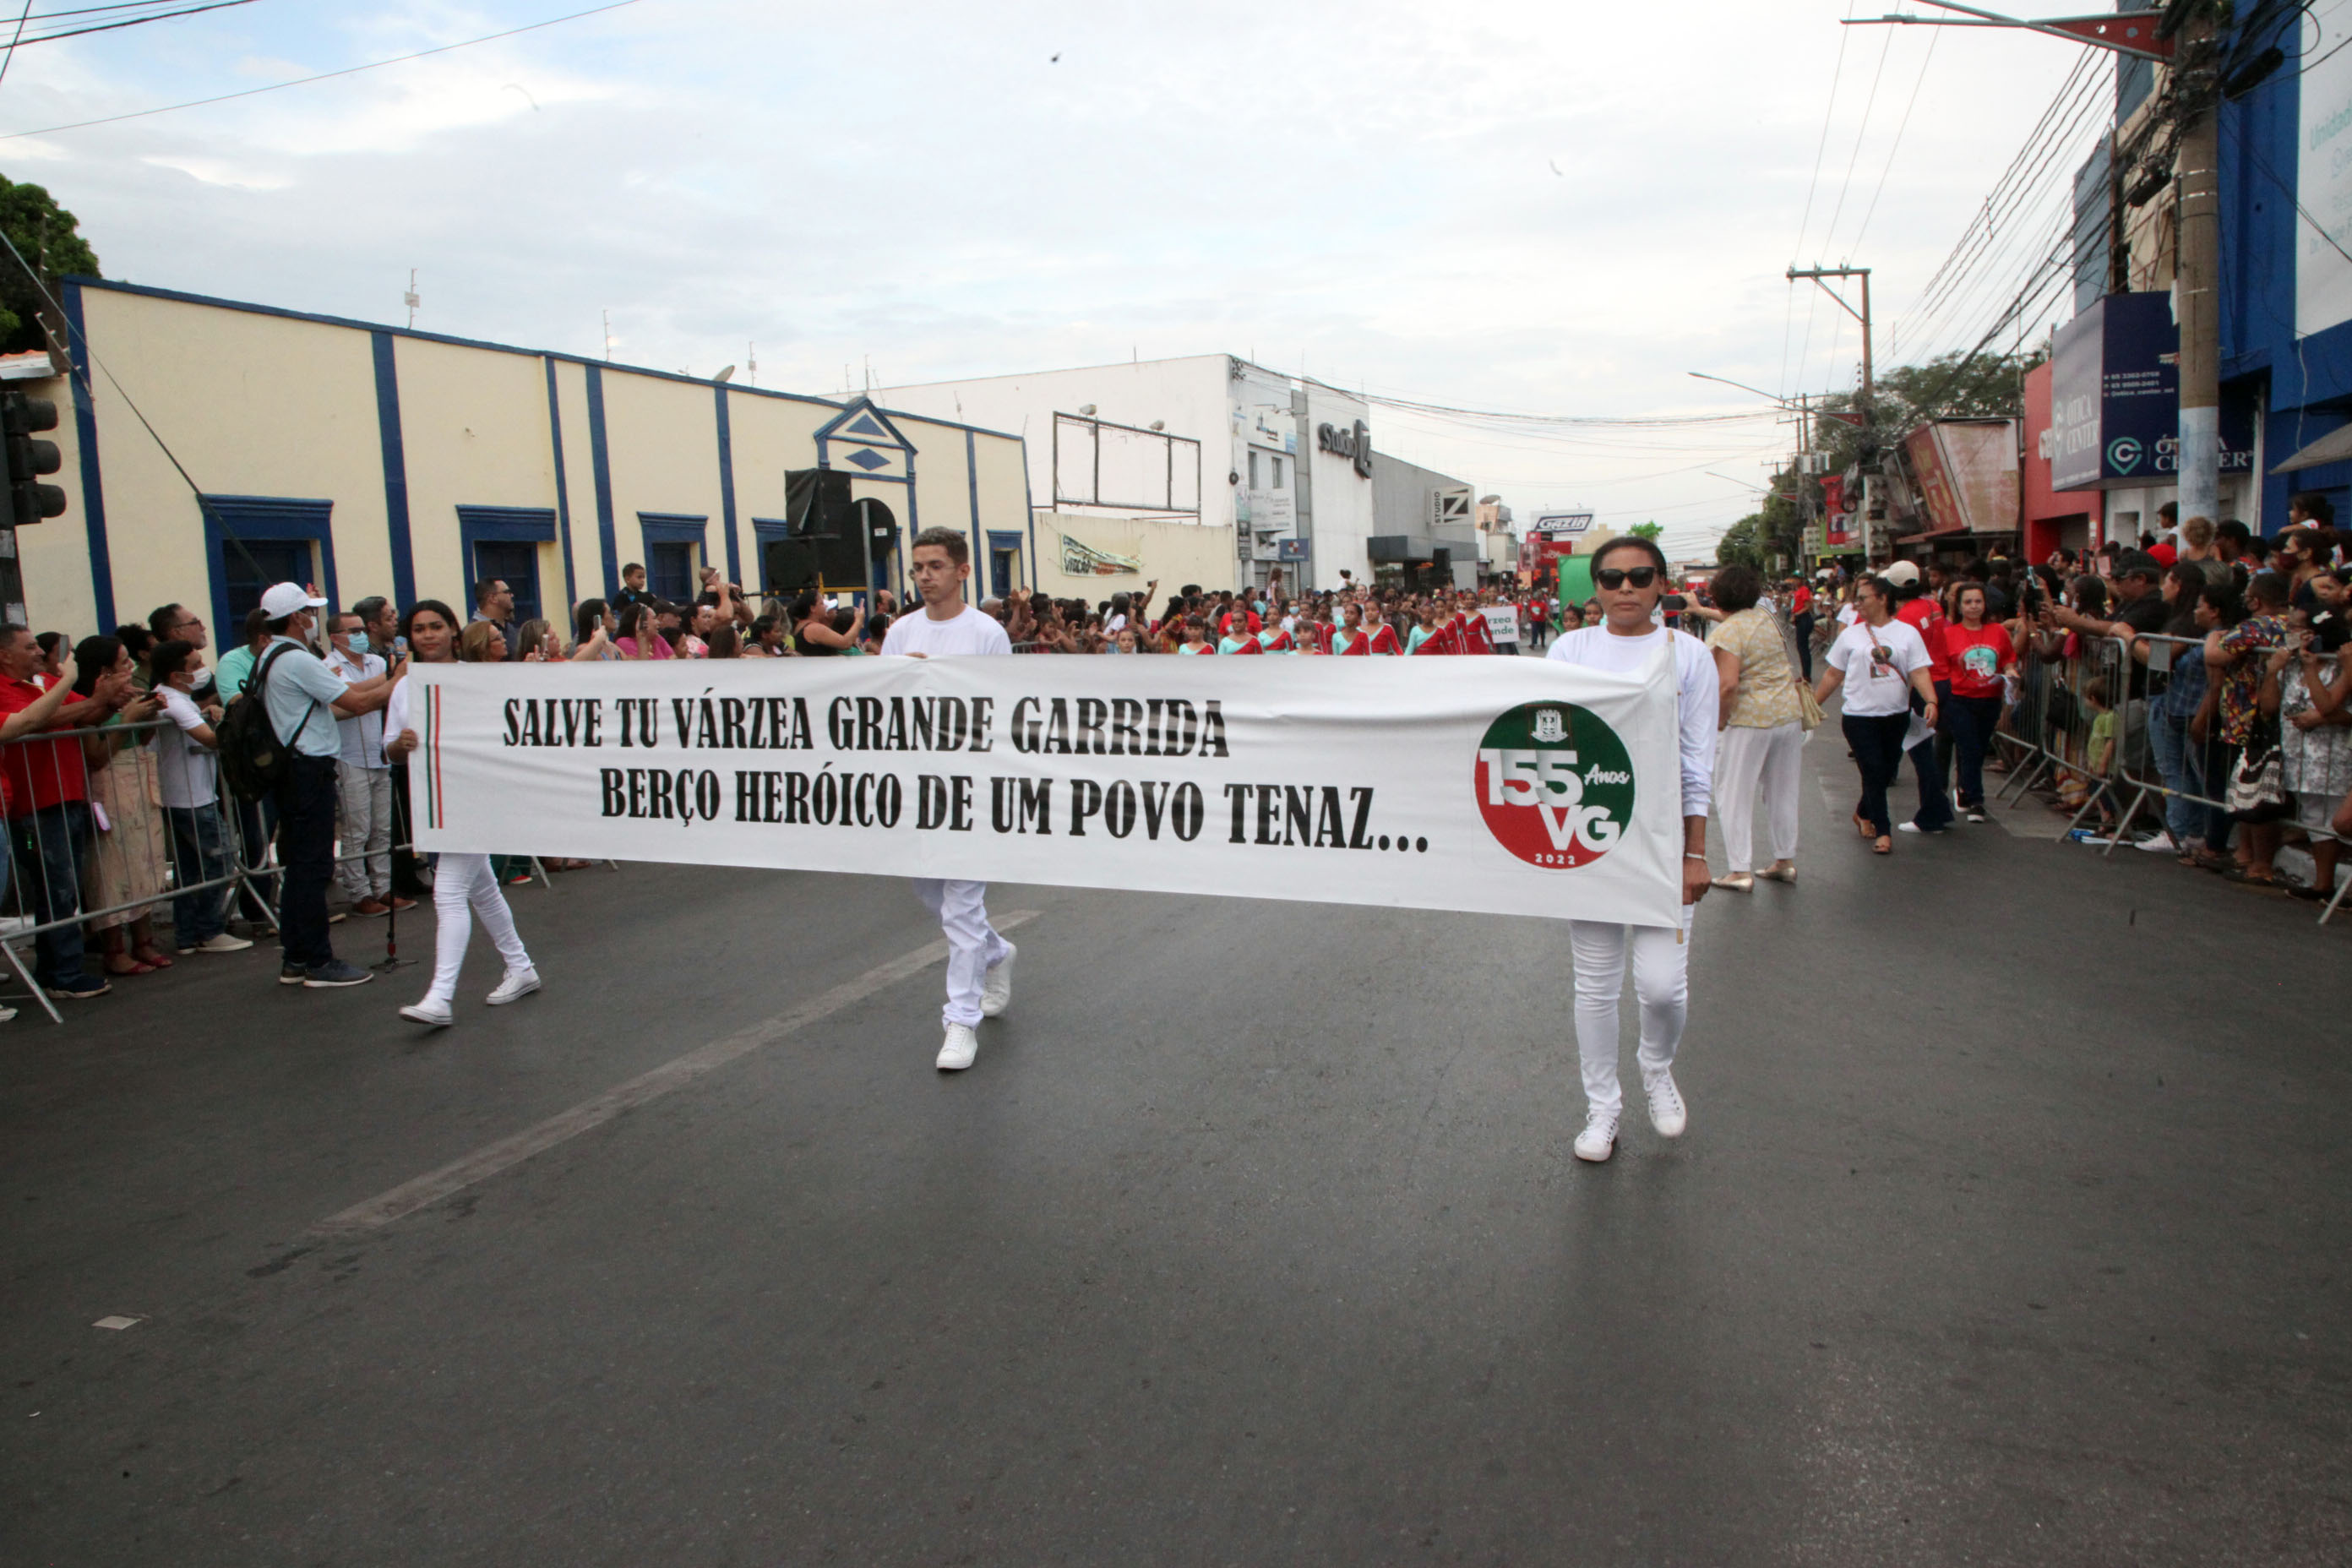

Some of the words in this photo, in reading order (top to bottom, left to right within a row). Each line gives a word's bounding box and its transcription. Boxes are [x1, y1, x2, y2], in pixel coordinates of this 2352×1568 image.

[1538, 514, 1591, 531] GAZIN
[1488, 616, 1511, 624] rzea
[504, 698, 602, 748] SALVE
[616, 698, 658, 749] TU
[672, 687, 814, 749] VÁRZEA
[829, 696, 994, 752] GRANDE
[1012, 696, 1229, 758] GARRIDA
[1479, 748, 1584, 808] 155
[1584, 764, 1630, 786] Anos
[601, 768, 721, 827] BERÇO
[736, 761, 902, 829] HERÓICO
[917, 775, 973, 831] DE
[991, 776, 1054, 835] UM
[1070, 779, 1204, 842] POVO
[1225, 783, 1428, 853] TENAZ...
[1538, 803, 1621, 852] VG
[1535, 853, 1576, 865] 2022
